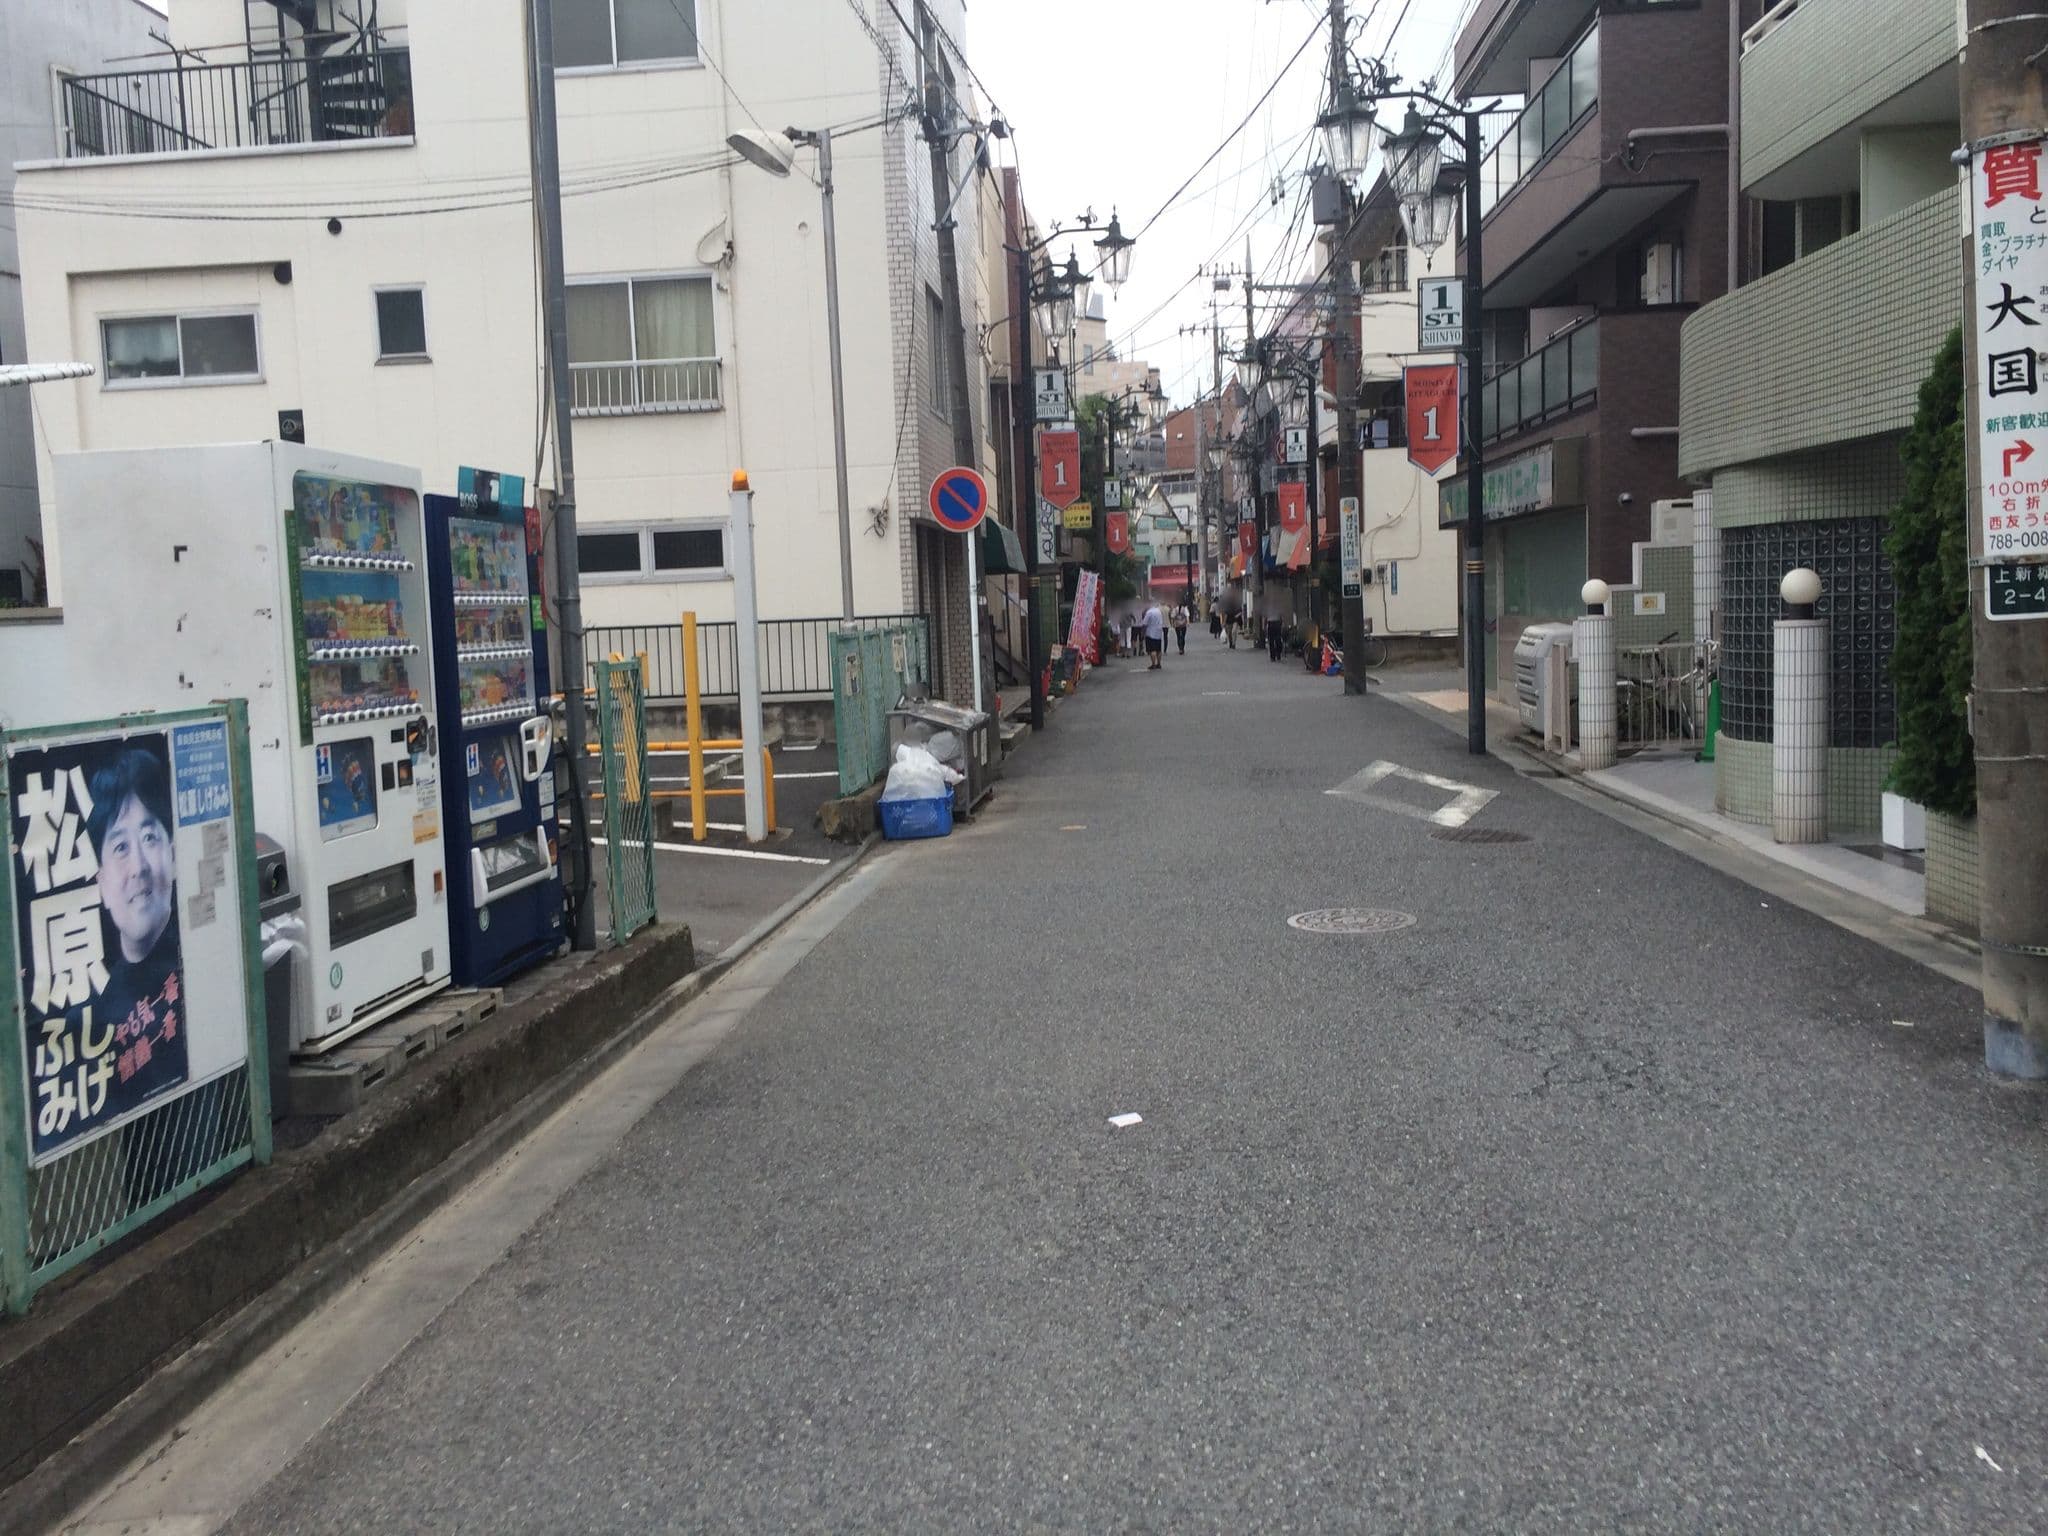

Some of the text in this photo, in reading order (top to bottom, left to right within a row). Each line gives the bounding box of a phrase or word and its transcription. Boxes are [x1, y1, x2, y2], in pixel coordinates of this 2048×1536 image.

[1983, 143, 2042, 208] 質
[1981, 221, 2006, 239] 買取
[1982, 254, 2019, 276] ダイヤ
[1431, 285, 1453, 311] 1
[1425, 312, 1460, 327] ST
[1424, 330, 1461, 345] SHINJYO
[1984, 282, 2042, 398] 大国
[1423, 407, 1441, 441] 1
[1055, 460, 1067, 486] 1
[460, 491, 479, 509] BOSS
[1288, 502, 1297, 520] 1
[2003, 496, 2040, 512] 右折
[18, 765, 111, 1015] 松原
